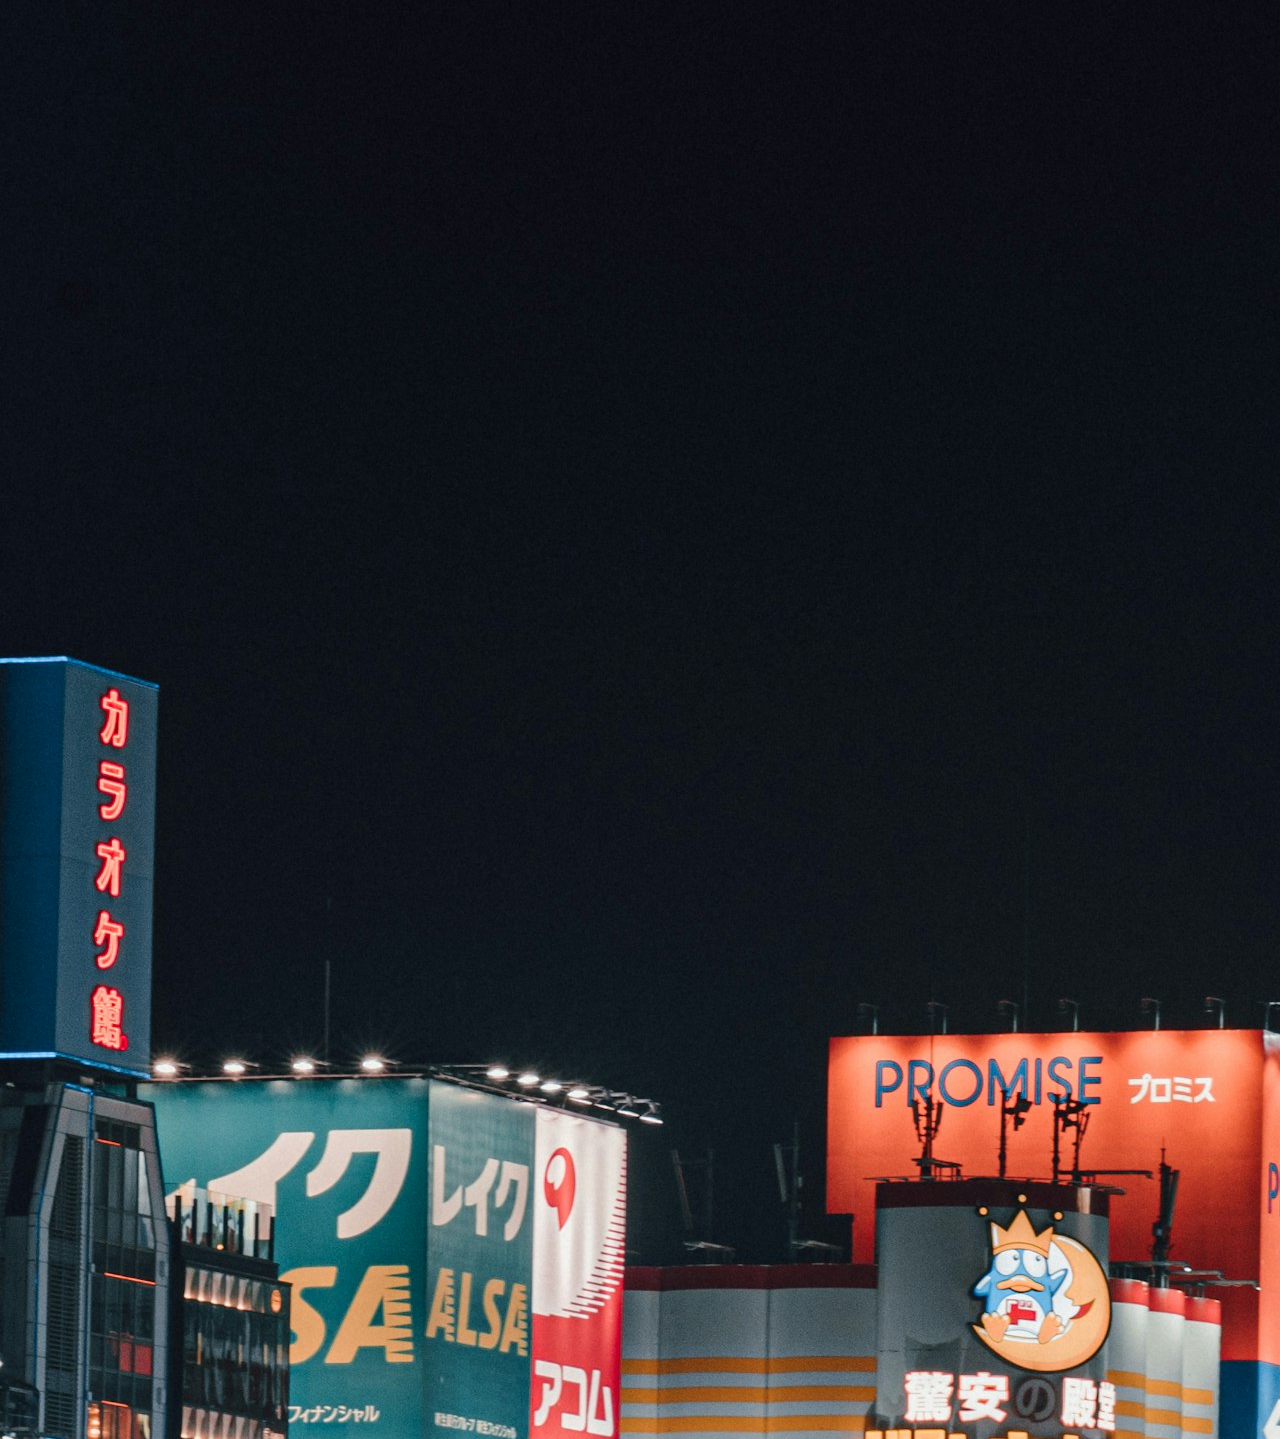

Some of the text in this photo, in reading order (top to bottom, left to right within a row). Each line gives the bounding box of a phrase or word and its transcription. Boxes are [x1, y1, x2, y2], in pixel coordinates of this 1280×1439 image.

[90, 687, 129, 1051] カラオケ館
[875, 1056, 1103, 1109] PROMISE
[1128, 1073, 1217, 1104] プロミス
[167, 1128, 413, 1240] イク
[431, 1144, 529, 1243] レイク
[288, 1265, 414, 1364] SA
[425, 1268, 528, 1358] ALSA
[534, 1360, 614, 1438] アコム
[904, 1371, 1117, 1431] 驚安の殿堂
